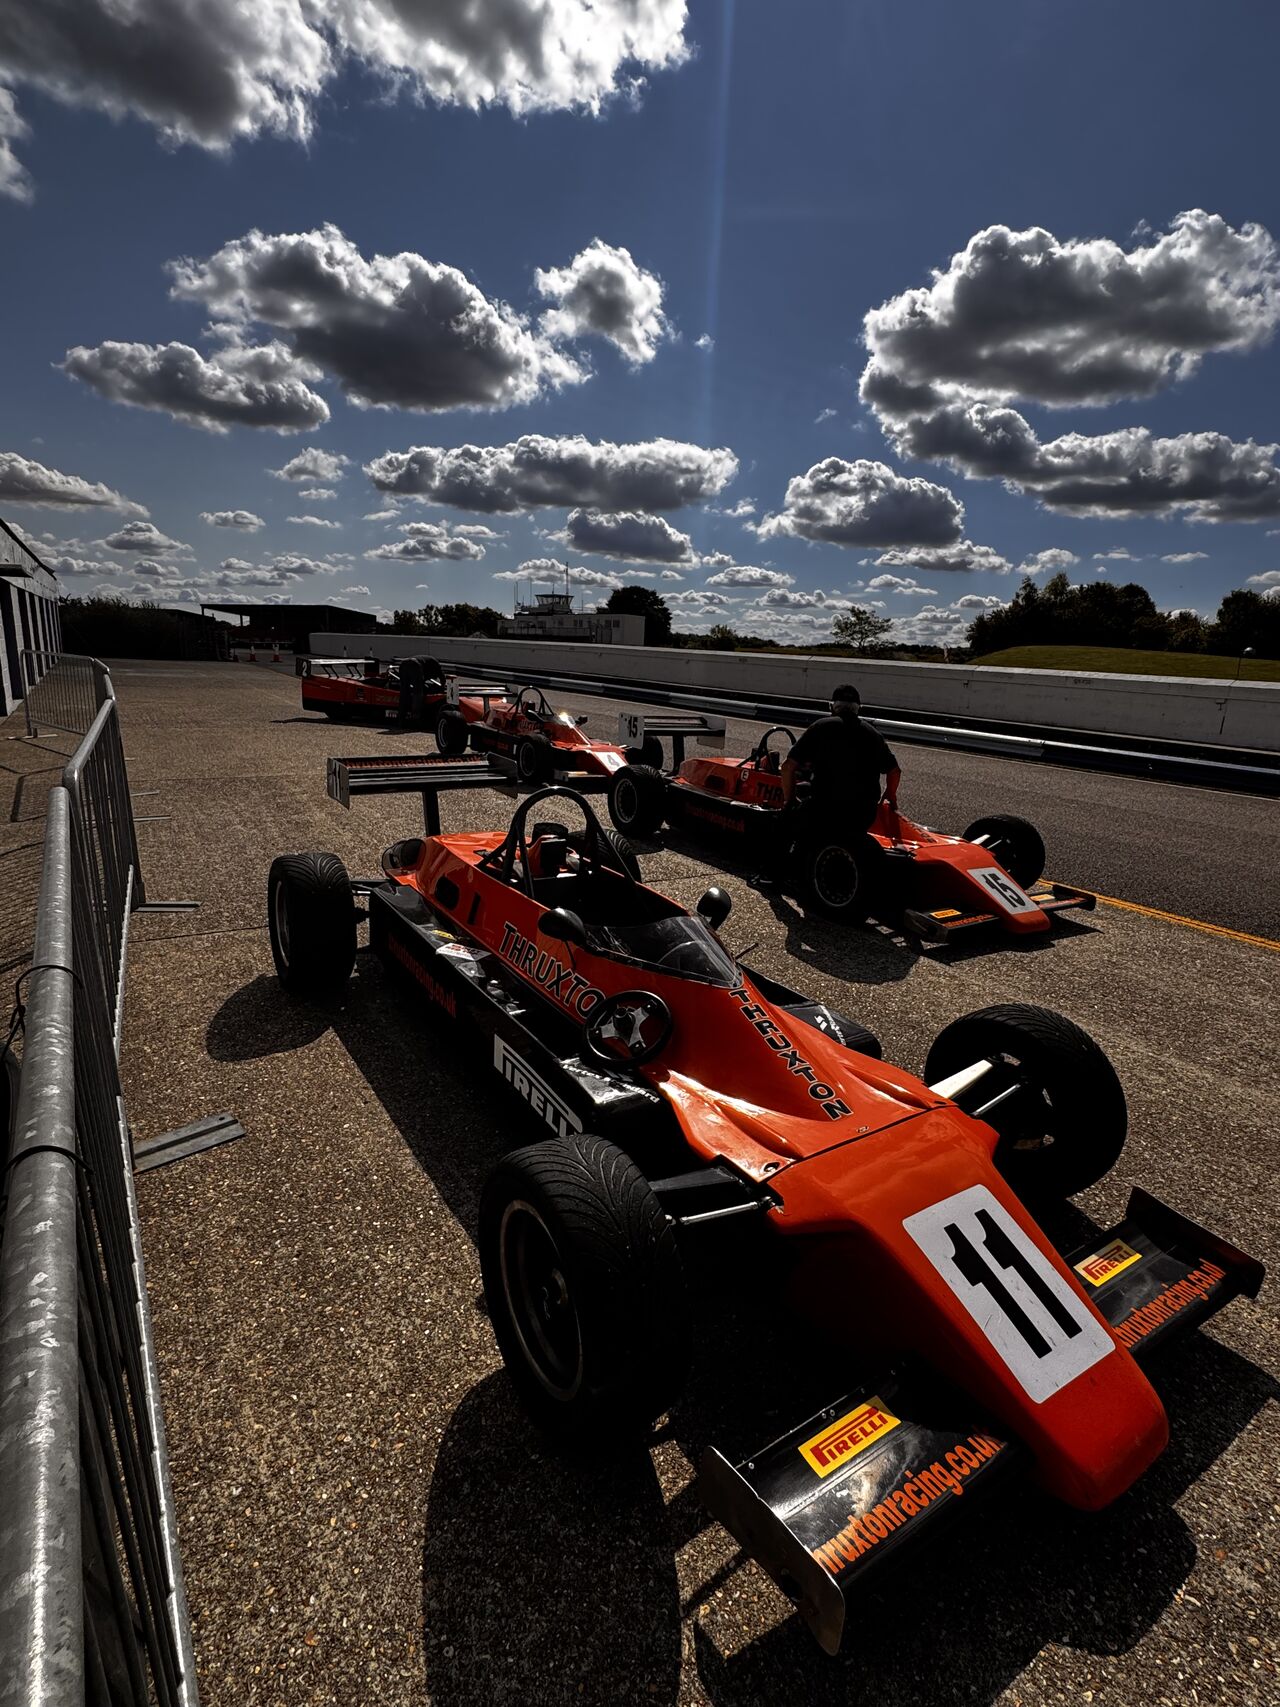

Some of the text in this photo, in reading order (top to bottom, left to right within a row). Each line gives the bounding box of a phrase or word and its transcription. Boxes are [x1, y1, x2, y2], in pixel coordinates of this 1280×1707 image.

[628, 716, 638, 738] 15
[607, 754, 620, 767] 4
[982, 873, 1027, 909] 15
[499, 921, 597, 1010] THRUXTO
[728, 989, 854, 1122] THRUXTON
[943, 1207, 1082, 1360] 11
[1083, 1244, 1136, 1281] PIRELLI
[809, 1406, 890, 1468] PIRELLI
